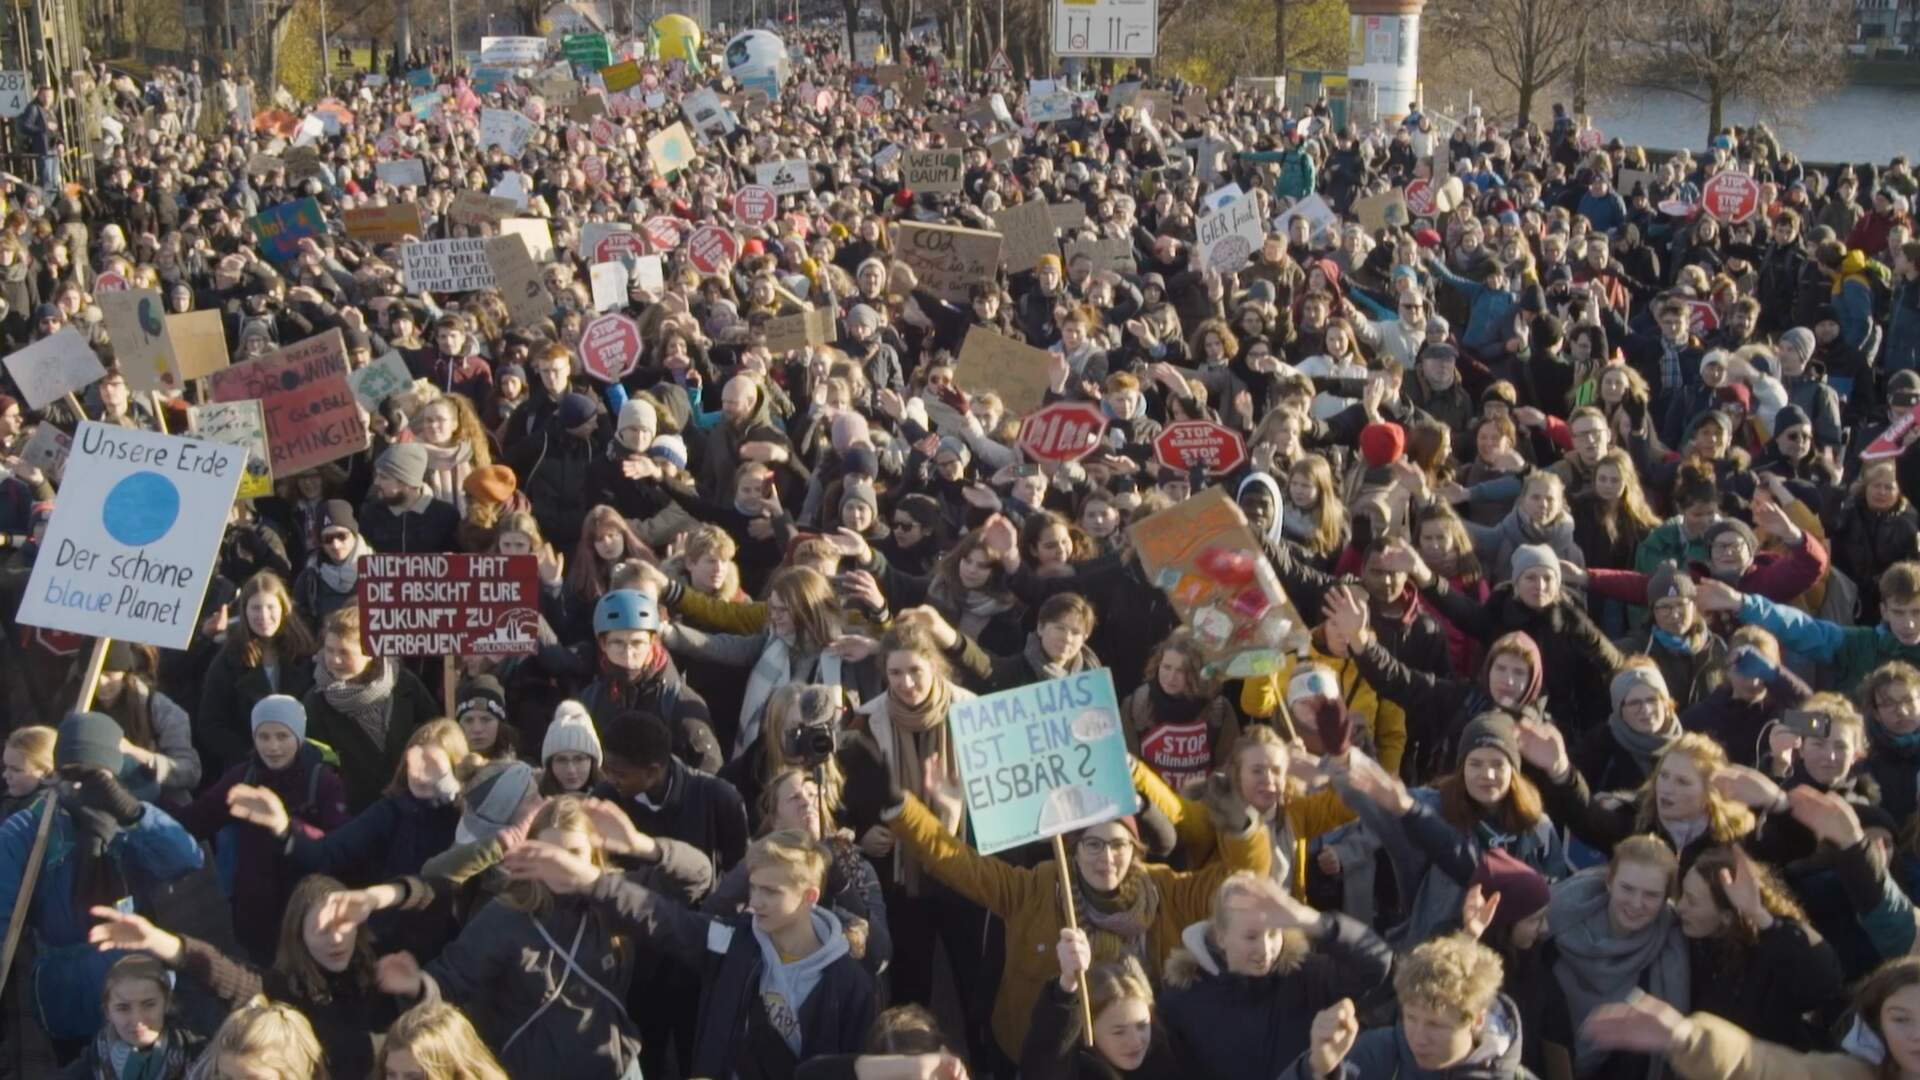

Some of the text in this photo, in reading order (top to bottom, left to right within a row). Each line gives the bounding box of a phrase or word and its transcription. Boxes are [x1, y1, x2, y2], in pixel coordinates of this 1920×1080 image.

[10, 94, 20, 109] 4
[910, 154, 946, 168] WEIL
[910, 169, 948, 183] BAUM
[1719, 175, 1746, 187] STOP
[1718, 195, 1743, 207] STOP
[1201, 212, 1228, 245] GIER
[428, 243, 444, 255] OLD
[913, 229, 956, 253] CO2
[457, 276, 473, 288] GET
[592, 320, 618, 337] STOP
[599, 340, 624, 358] STOP
[1174, 426, 1213, 439] STOP
[82, 427, 168, 466] Unsere
[177, 444, 229, 478] Erde
[1180, 447, 1219, 459] STOP
[56, 538, 193, 588] Der schöne
[469, 556, 508, 578] HAT
[44, 577, 181, 625] blaue Planet
[367, 582, 521, 602] DIE ABSICHT EURE
[369, 607, 493, 631] ZUKUNFT ZU
[956, 675, 1093, 736] MAMA, WAS
[962, 717, 1070, 773] IST EIN
[1163, 734, 1206, 754] STOP
